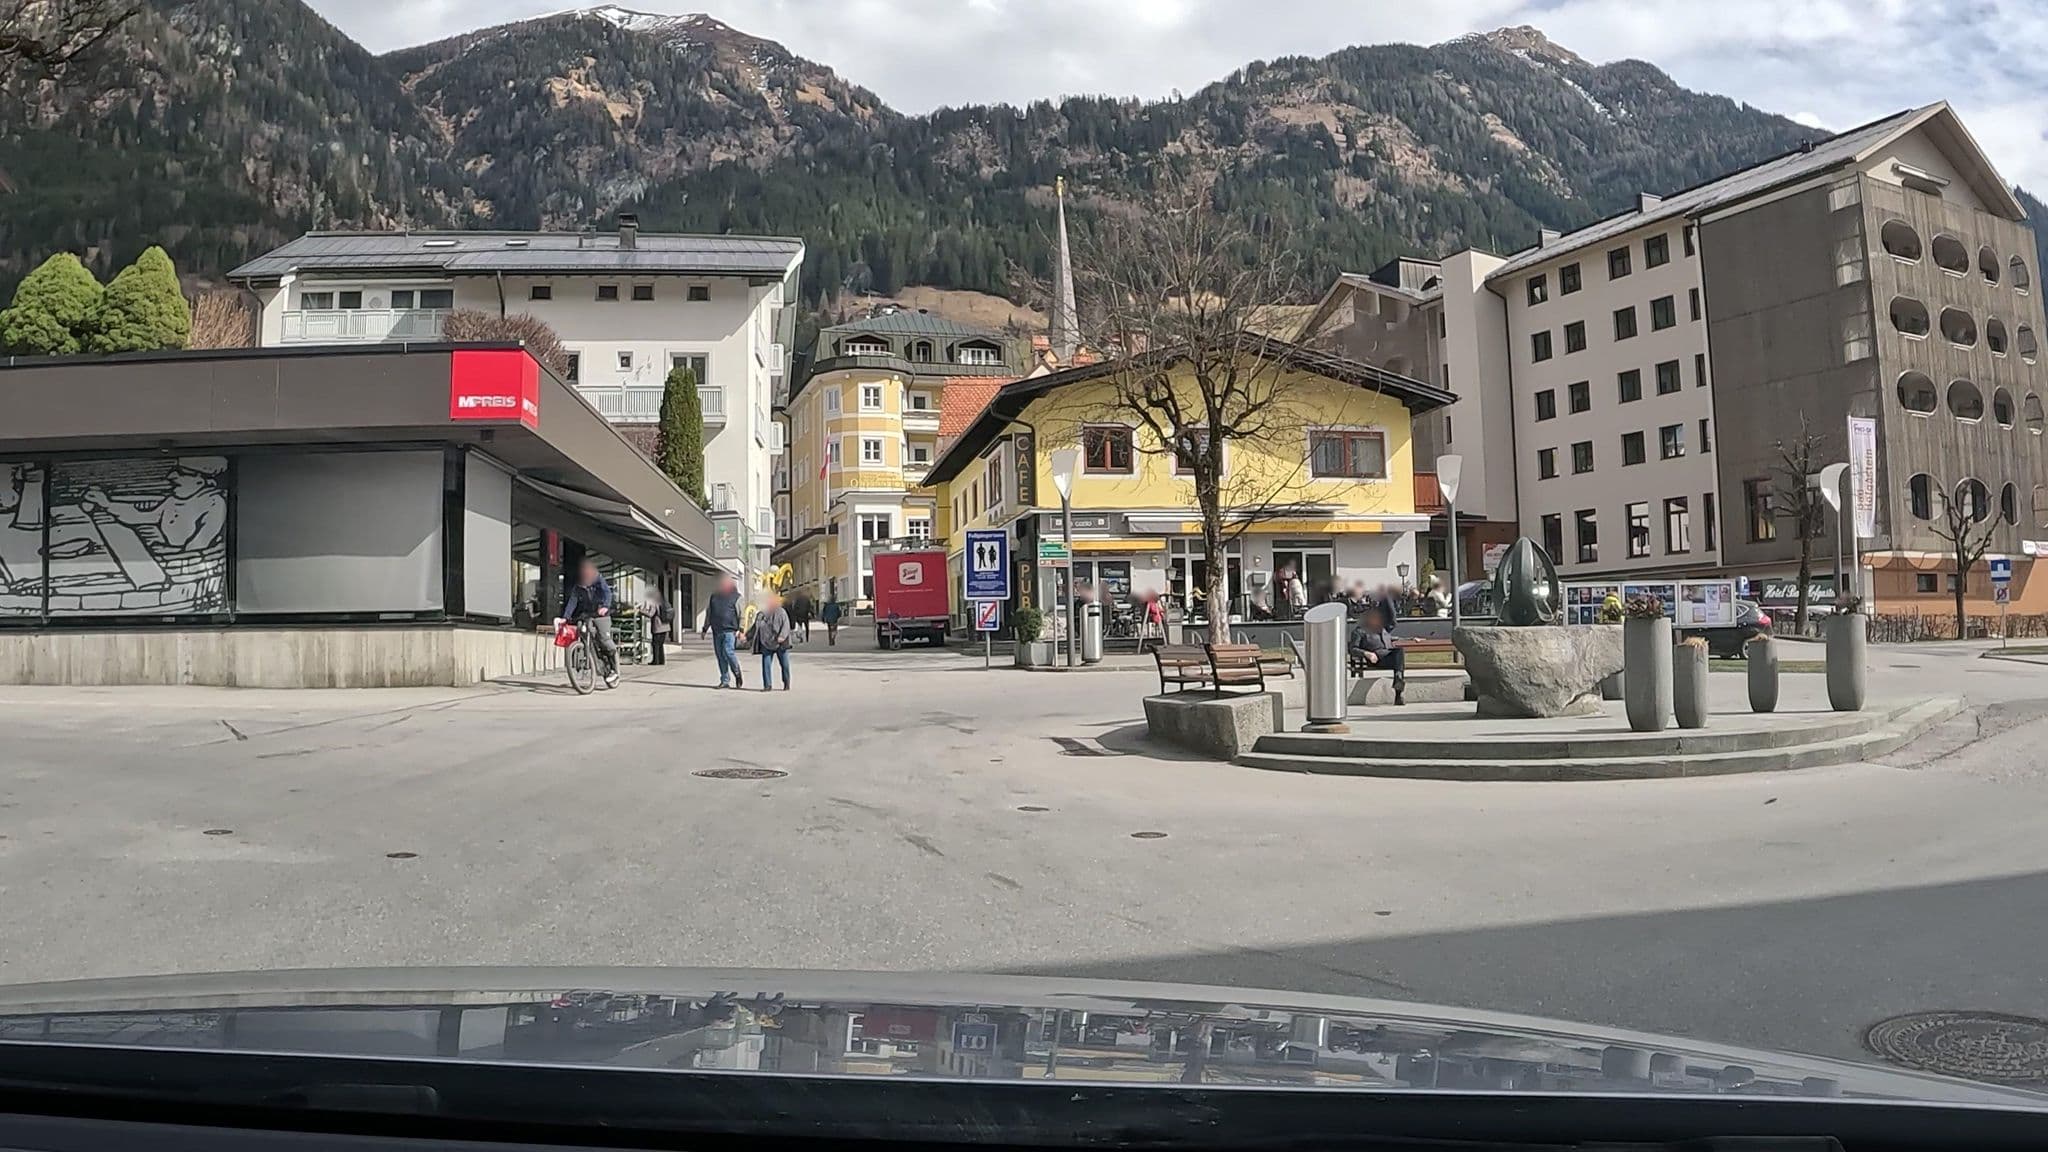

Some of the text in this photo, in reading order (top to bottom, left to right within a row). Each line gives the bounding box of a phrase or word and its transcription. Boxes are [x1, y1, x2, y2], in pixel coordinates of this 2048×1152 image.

[458, 396, 516, 408] MPREIS
[1021, 564, 1032, 608] PUB
[1741, 576, 1748, 589] P
